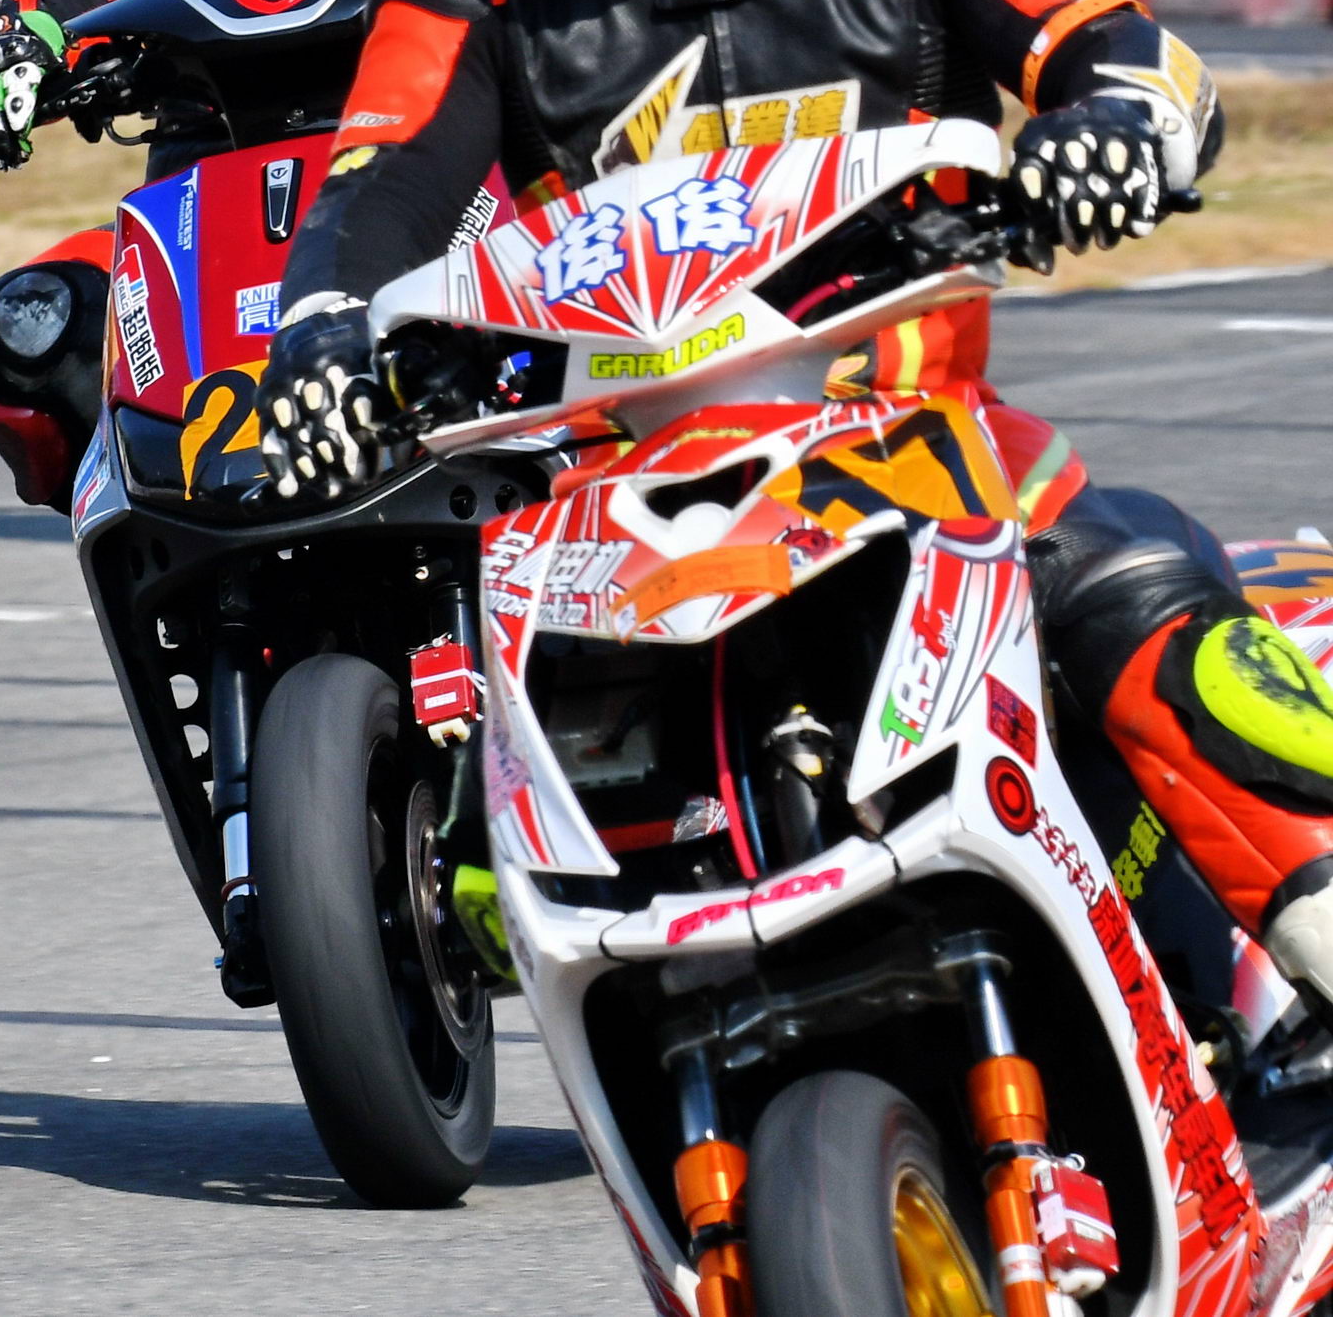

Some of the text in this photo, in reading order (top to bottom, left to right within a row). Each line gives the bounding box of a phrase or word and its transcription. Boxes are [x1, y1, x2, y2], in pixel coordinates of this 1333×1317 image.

[121, 304, 162, 392] 超跑版
[589, 312, 745, 380] GARUDA
